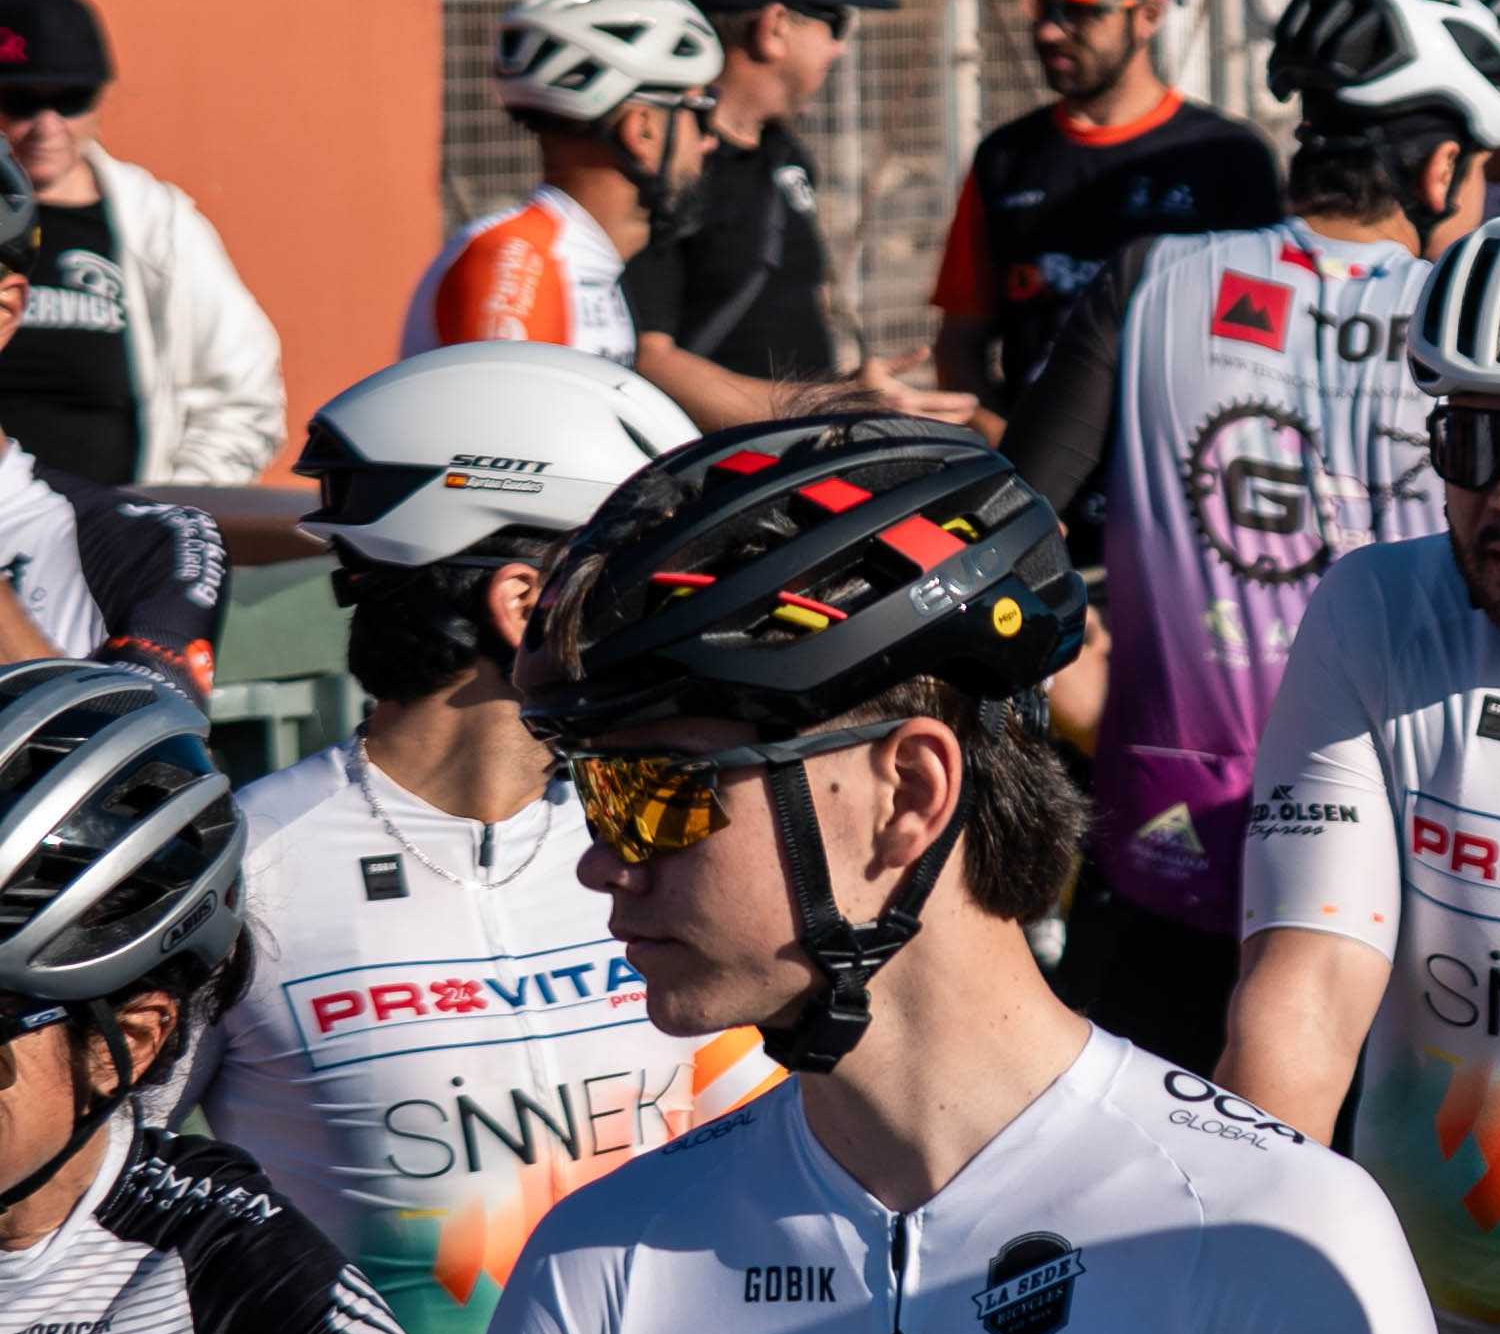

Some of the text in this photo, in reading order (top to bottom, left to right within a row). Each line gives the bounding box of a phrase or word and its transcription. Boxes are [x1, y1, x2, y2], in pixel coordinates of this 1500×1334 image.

[449, 453, 554, 473] SCOTT
[1163, 1071, 1306, 1146] OCA
[1169, 1107, 1269, 1153] GLOBAL
[662, 1109, 756, 1157] GLOBAL
[744, 1266, 837, 1304] GOBIK
[983, 1259, 1071, 1311] LA SEDE
